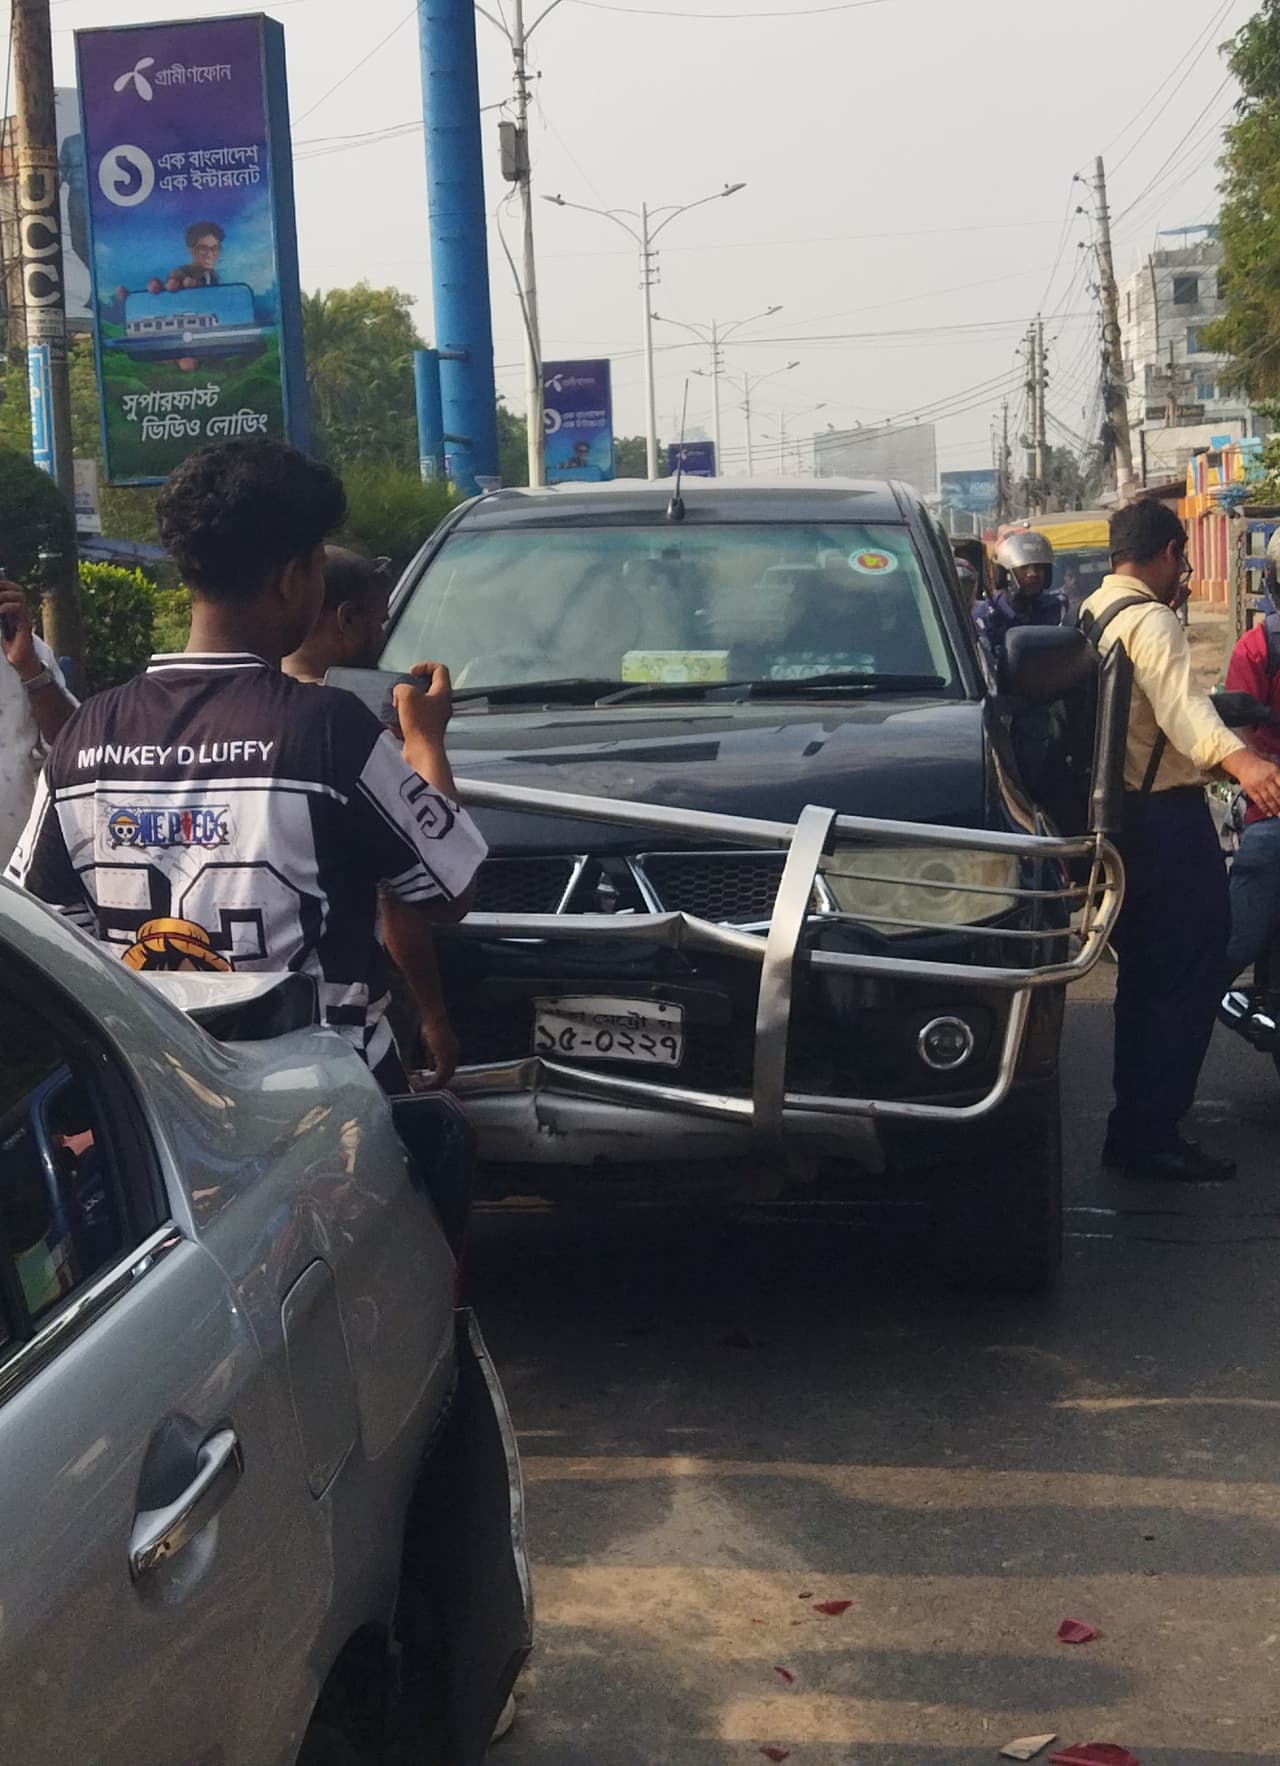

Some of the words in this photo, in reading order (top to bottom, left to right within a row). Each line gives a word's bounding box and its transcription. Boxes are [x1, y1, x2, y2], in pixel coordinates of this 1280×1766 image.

[155, 63, 232, 86] গ্রামীণফোন
[157, 152, 185, 169] এক
[189, 144, 259, 168] বাংলাদেশ
[159, 174, 187, 191] এক
[191, 164, 260, 190] ইন্টারনেট
[122, 382, 220, 421] সুপারফাস্ট
[141, 414, 201, 441] ভিডিও
[206, 408, 268, 436] লোডিং
[177, 745, 194, 766] D
[198, 740, 275, 764] LUFFY
[536, 1024, 677, 1060] ১৫-০২২৭
